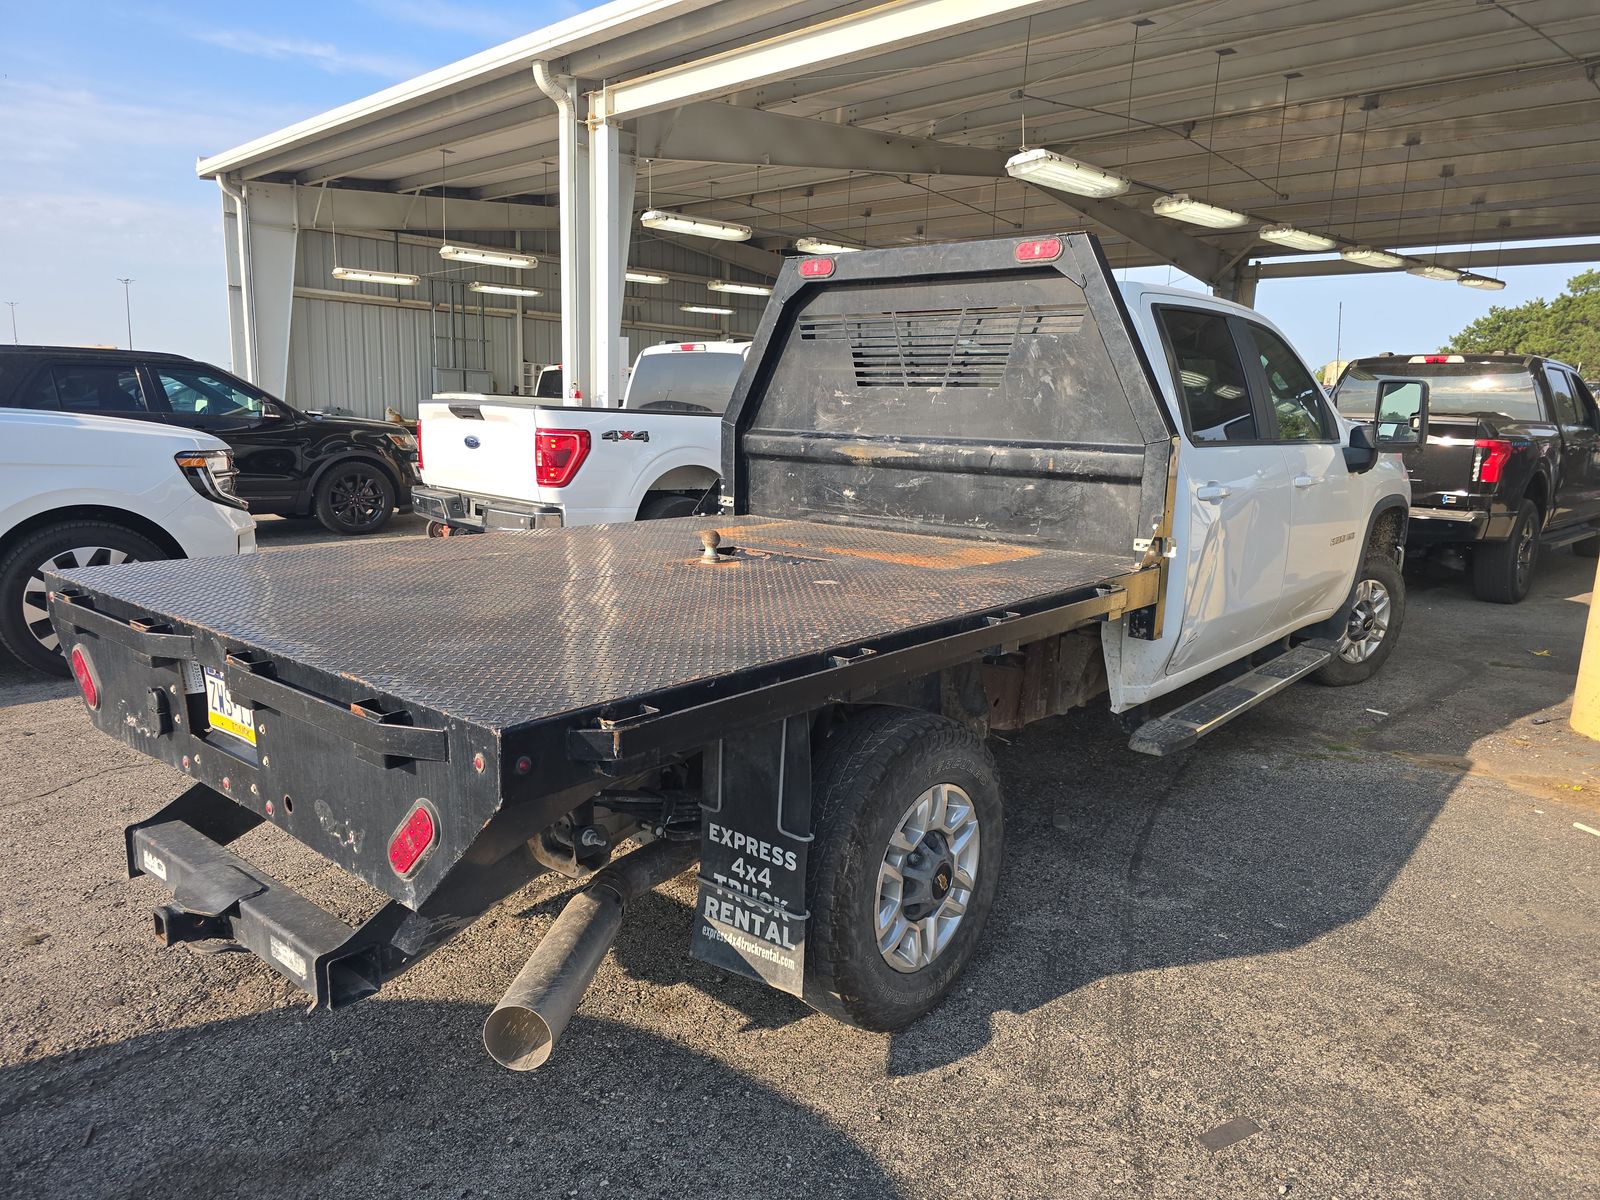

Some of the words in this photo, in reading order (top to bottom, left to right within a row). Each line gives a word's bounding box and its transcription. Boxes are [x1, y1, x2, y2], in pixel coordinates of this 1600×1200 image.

[709, 822, 797, 871] EXPRESS
[713, 872, 789, 922] TRUCK
[731, 857, 772, 889] 4x4
[701, 924, 795, 971] express4x4truckrental.com
[704, 895, 796, 951] RENTAL
